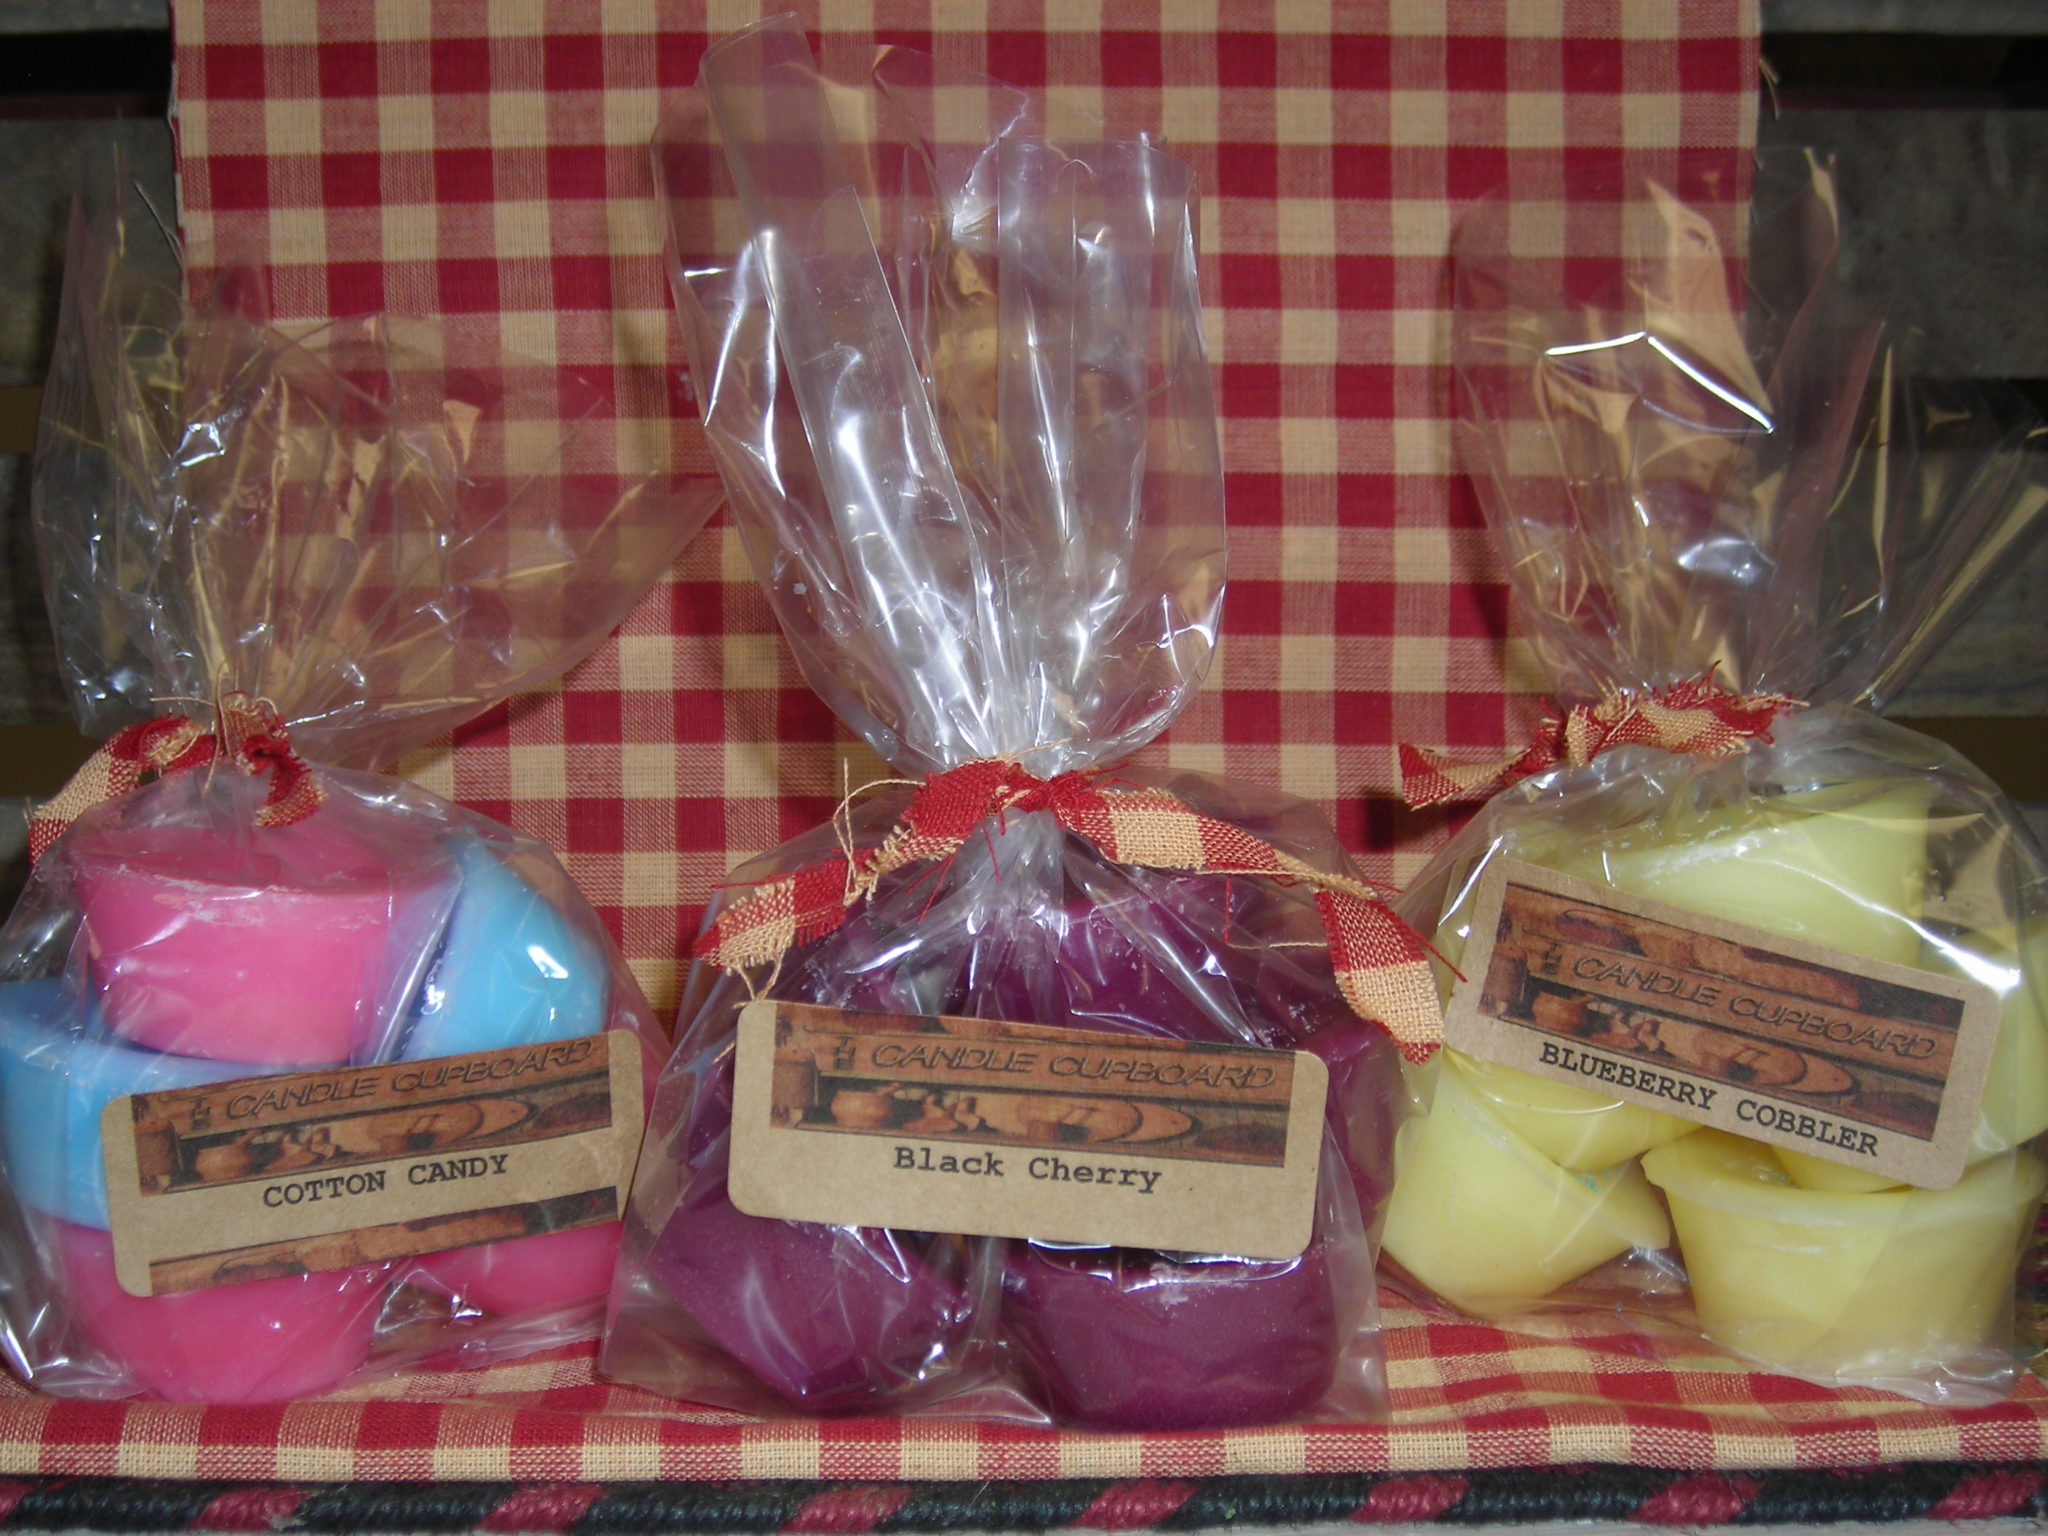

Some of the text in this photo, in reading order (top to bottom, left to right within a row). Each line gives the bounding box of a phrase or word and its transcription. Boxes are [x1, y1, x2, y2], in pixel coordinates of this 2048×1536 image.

[1573, 956, 1937, 1060] CANDLE CUPBOARD
[226, 1039, 594, 1120] CANDLE CUPBOARD
[871, 1043, 1276, 1092] CANDLE CUPBOARD
[1539, 1041, 1879, 1157] BLUEBERRY COBBLER
[262, 1154, 510, 1208] COTTON CANDY
[893, 1146, 1163, 1194] Black Cherry
